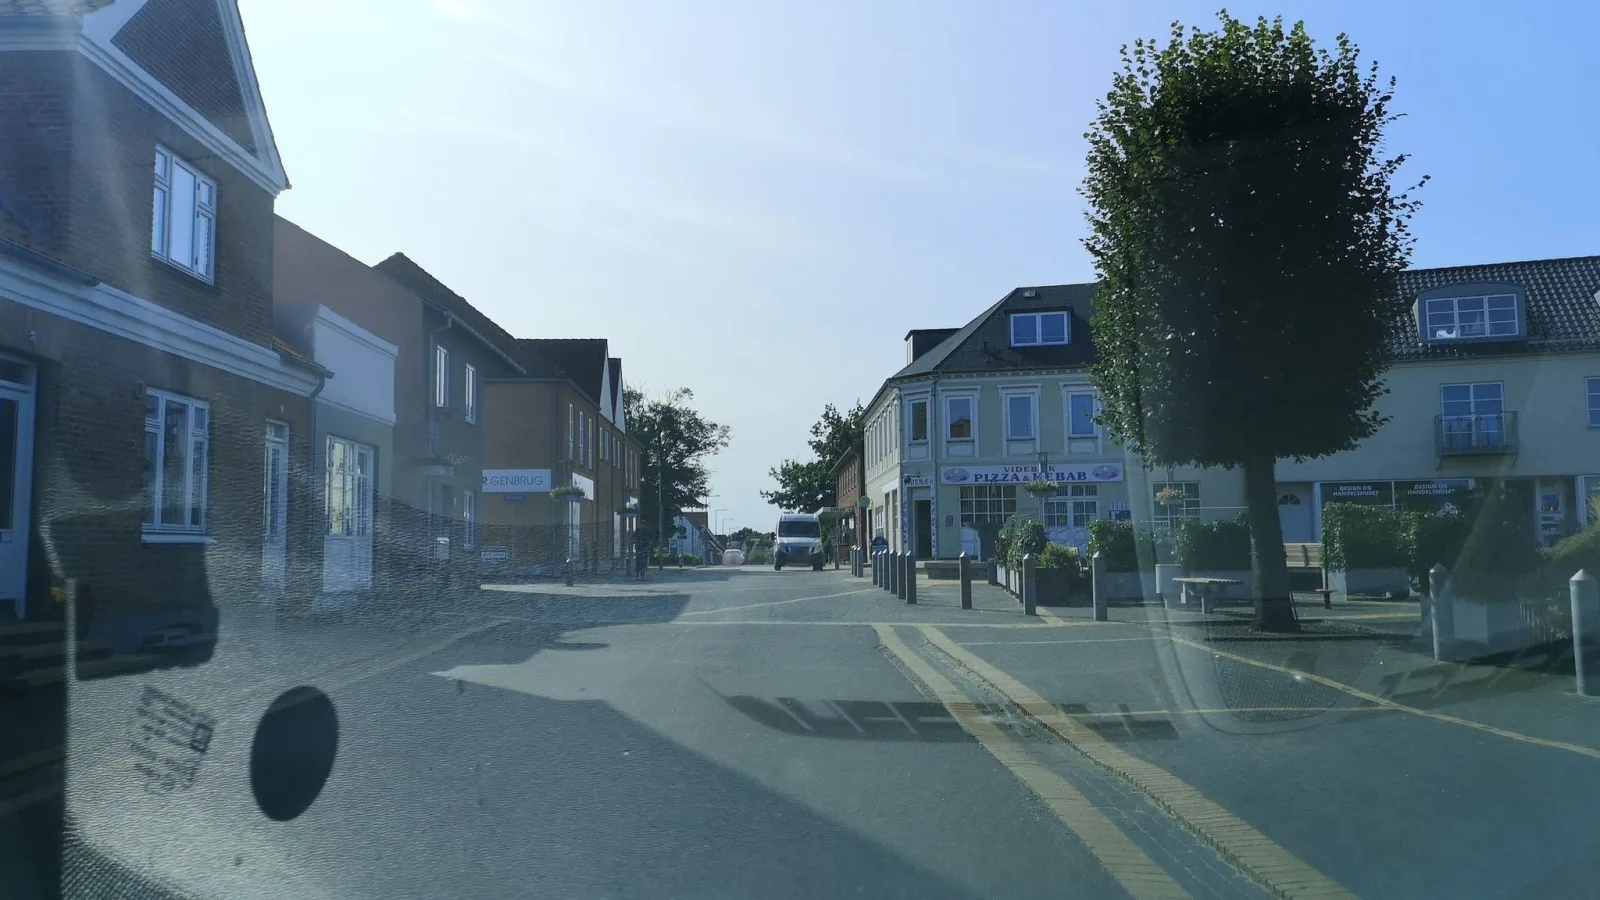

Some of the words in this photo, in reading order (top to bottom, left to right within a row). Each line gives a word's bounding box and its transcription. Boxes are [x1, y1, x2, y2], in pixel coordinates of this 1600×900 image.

[490, 476, 543, 486] GENBRUG
[974, 473, 1020, 482] PIZZA
[1033, 472, 1087, 481] KEBAB
